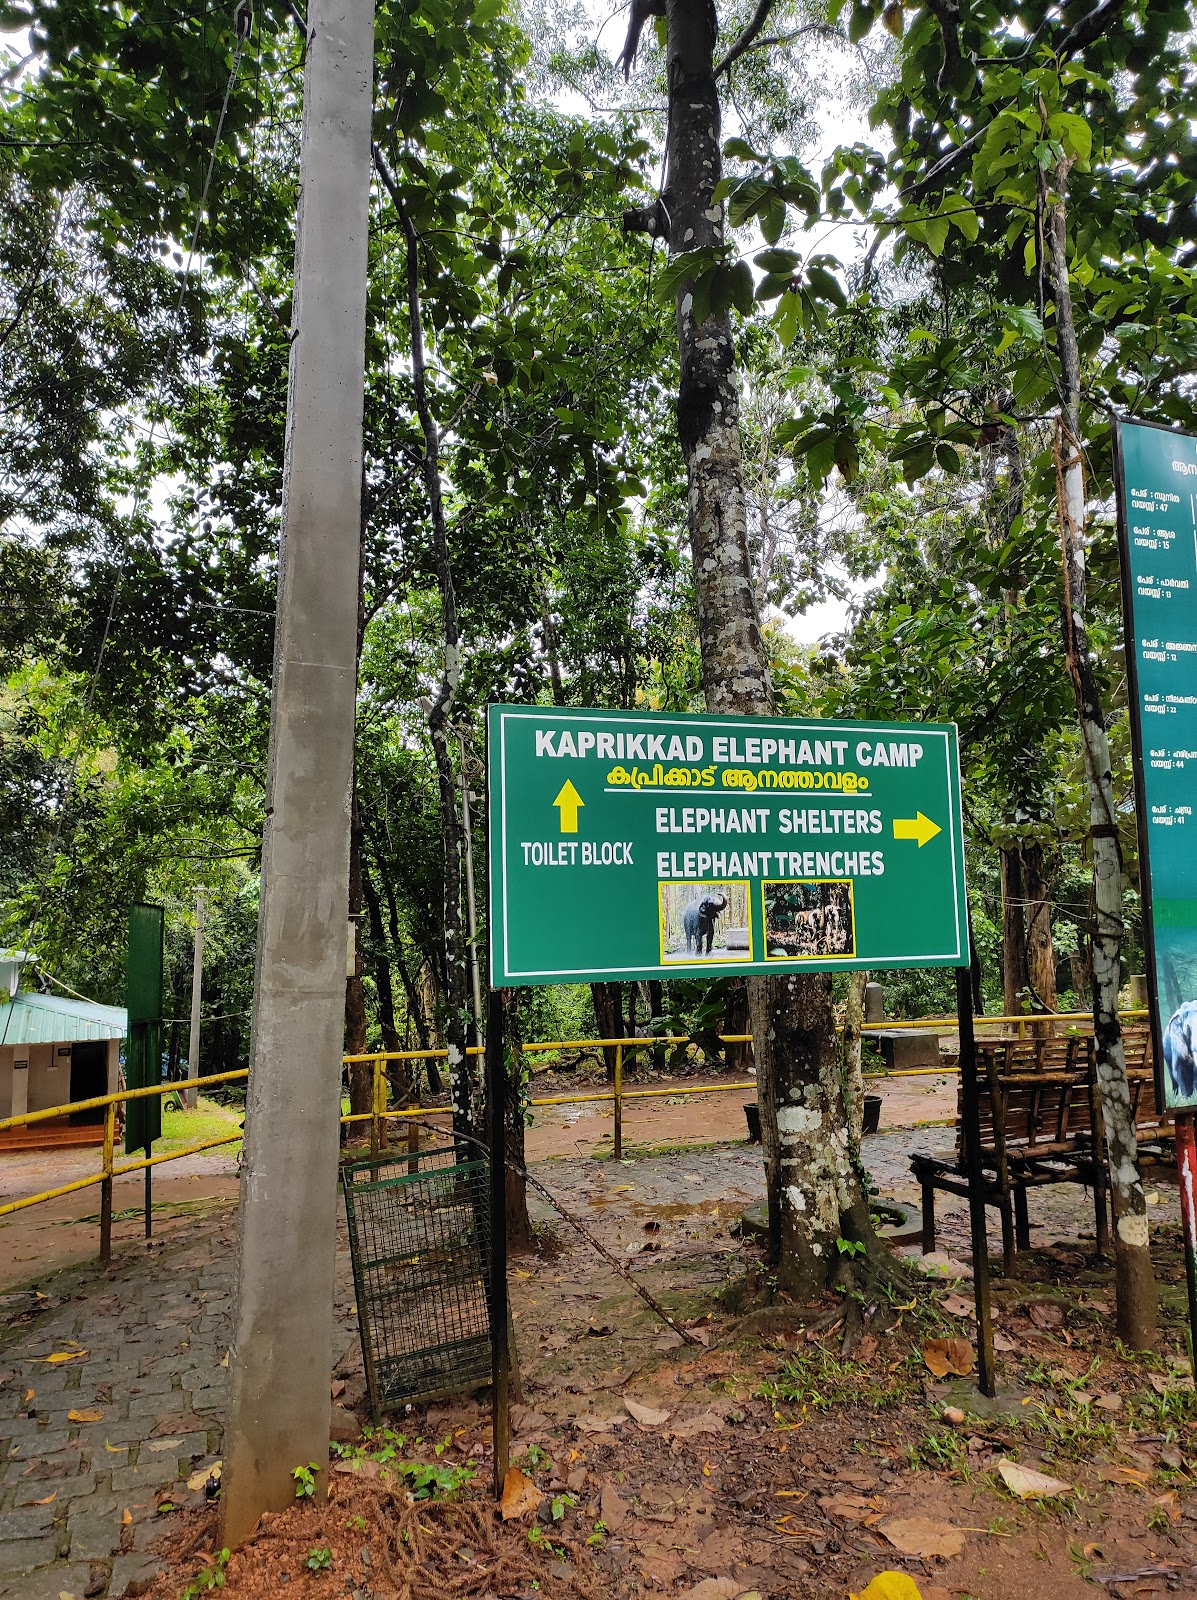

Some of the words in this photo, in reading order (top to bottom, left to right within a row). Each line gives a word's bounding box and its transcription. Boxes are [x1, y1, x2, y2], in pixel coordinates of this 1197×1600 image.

[1159, 503, 1168, 513] 47
[1162, 540, 1170, 550] 15
[1165, 590, 1172, 599] 13
[1170, 653, 1178, 662] 12
[1169, 706, 1177, 714] 22
[535, 729, 704, 763] KAPRIKKAD
[712, 736, 848, 766] ELEPHANT
[855, 741, 924, 768] CAMP
[1175, 760, 1185, 769] 44
[606, 763, 718, 789] കപ്രിക്കാട്
[721, 766, 870, 793] ആനത്താവളം
[655, 807, 770, 833] ELEPHANT
[778, 808, 883, 834] SHELTERS
[1177, 816, 1185, 825] 41
[520, 840, 579, 867] TOILET
[581, 840, 634, 867] BLOCK
[656, 850, 771, 878] ELEPHANT
[773, 850, 885, 878] TRENCHES
